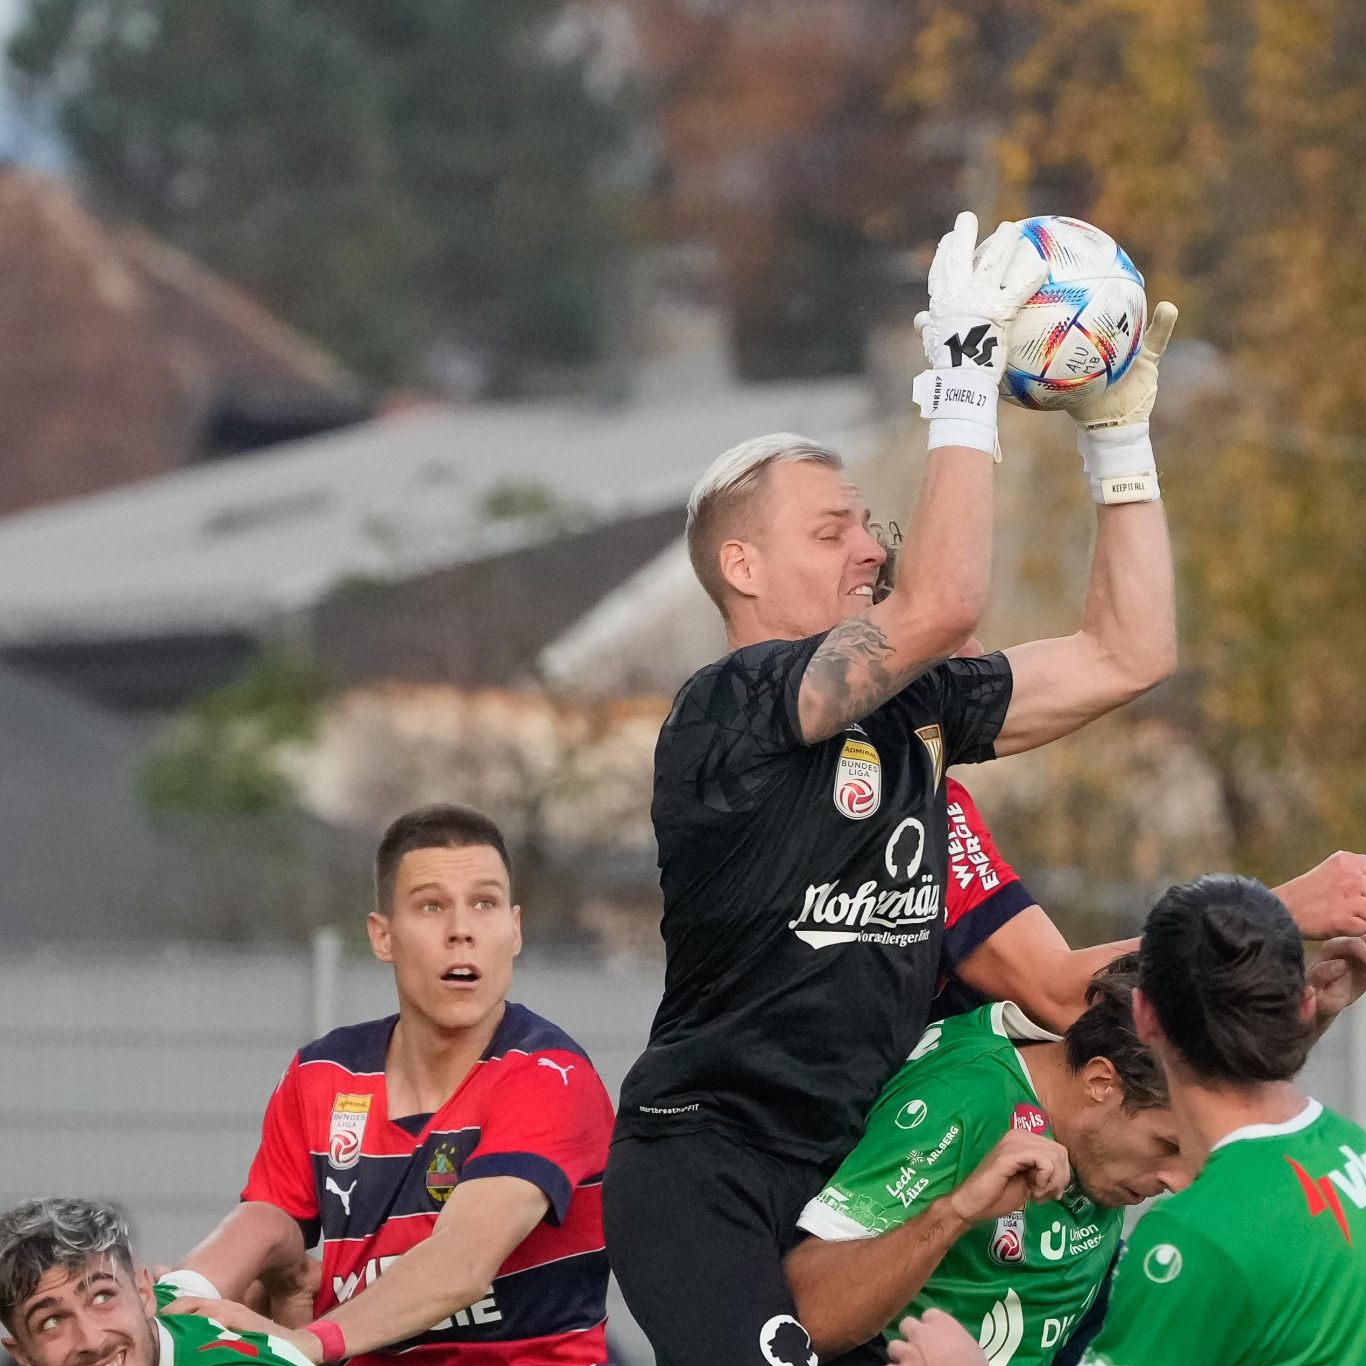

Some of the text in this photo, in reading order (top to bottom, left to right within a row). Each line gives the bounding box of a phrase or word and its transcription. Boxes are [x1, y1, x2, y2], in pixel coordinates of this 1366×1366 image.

[1066, 346, 1089, 374] ALU
[944, 388, 987, 408] SCHIERL 27
[844, 745, 877, 760] ADMIRAL
[841, 760, 878, 773] BUNDES
[848, 769, 870, 778] LIGA
[926, 1125, 960, 1166] ARLBERG
[886, 1166, 917, 1198] Lech
[1069, 1222, 1099, 1242] Union
